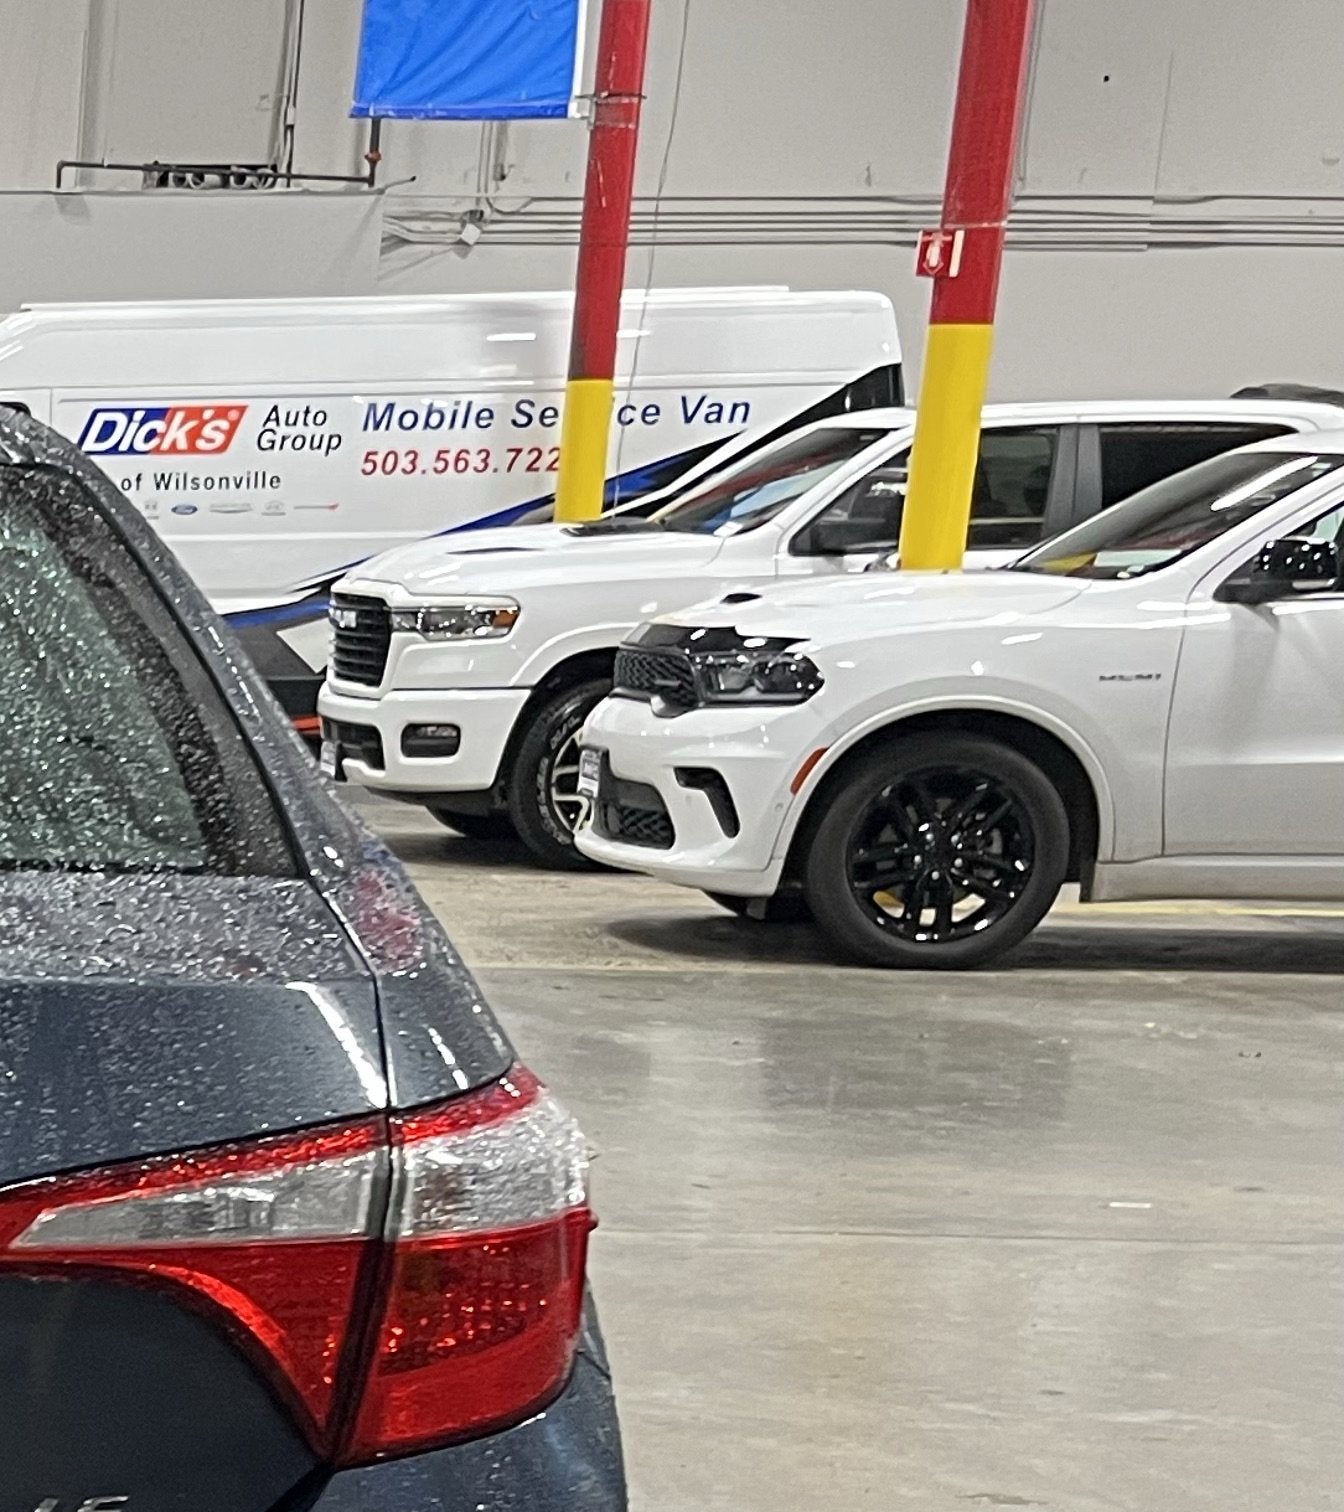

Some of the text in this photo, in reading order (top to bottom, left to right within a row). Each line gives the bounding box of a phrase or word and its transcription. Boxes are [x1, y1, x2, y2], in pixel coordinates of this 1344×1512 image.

[262, 405, 328, 428] Auto
[362, 394, 751, 432] Mobile Sece Van
[80, 409, 231, 451] Dick's
[257, 428, 343, 457] Group
[360, 447, 561, 476] 503.563.722
[120, 470, 282, 491] of Wilsonville
